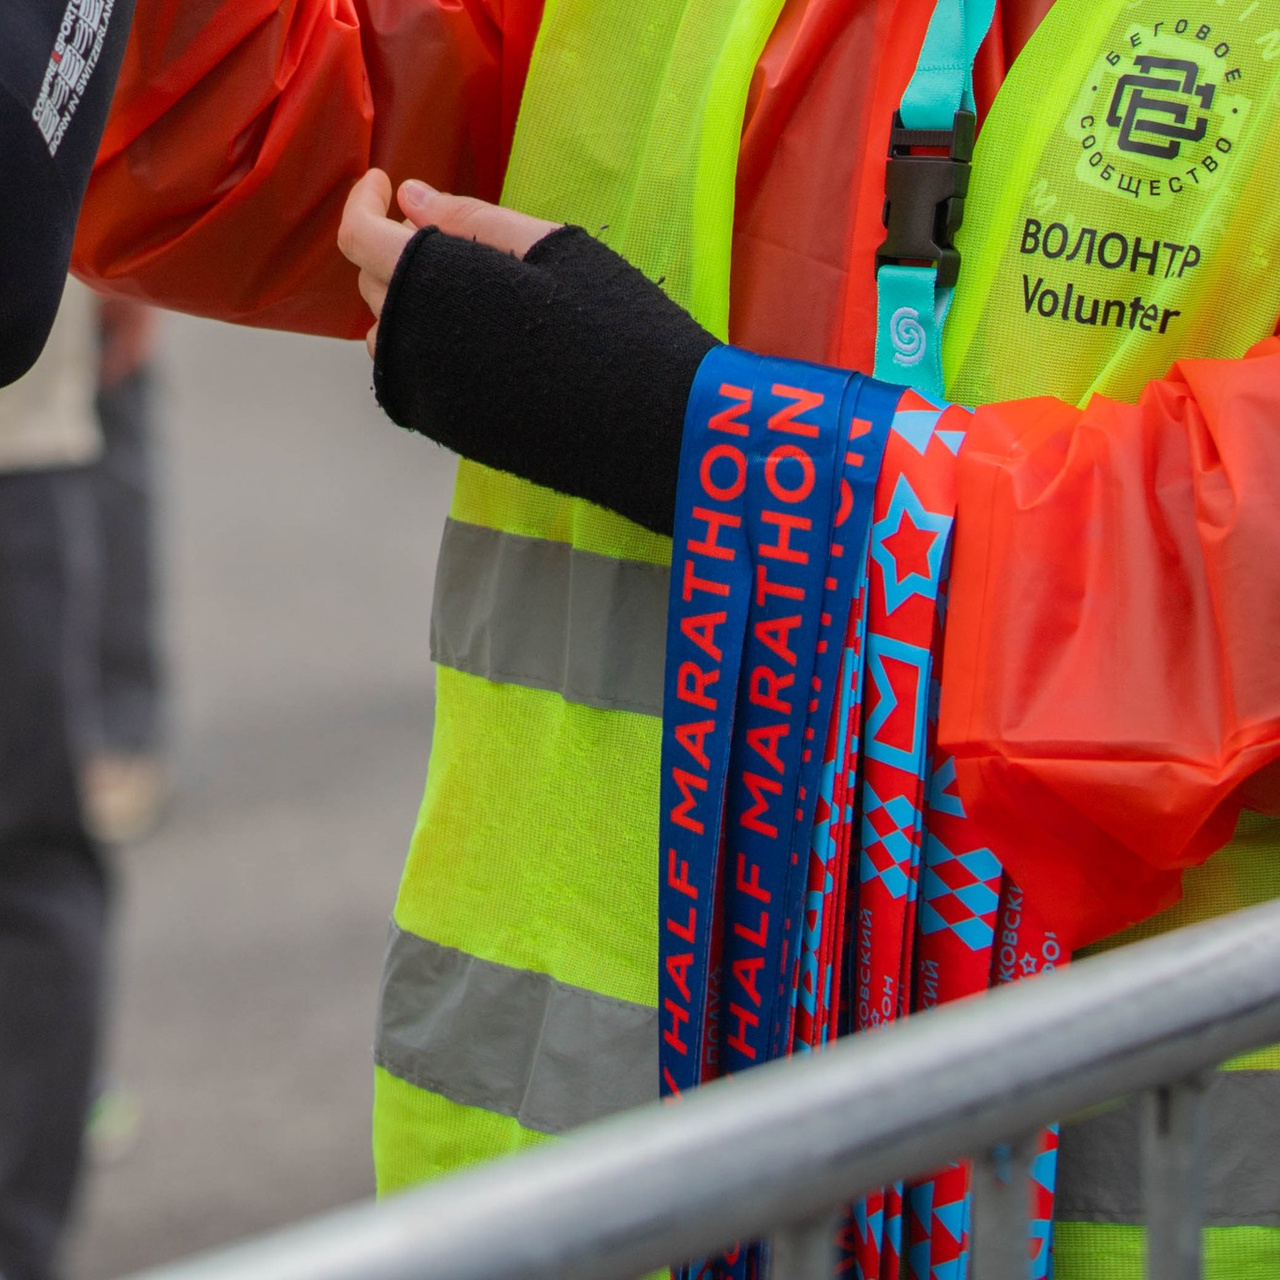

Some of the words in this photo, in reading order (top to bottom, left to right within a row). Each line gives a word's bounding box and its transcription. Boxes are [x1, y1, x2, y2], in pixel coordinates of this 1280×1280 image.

[48, 114, 72, 159] BORN
[67, 93, 81, 115] IN
[1080, 114, 1233, 198] СООБЩЕСТВО
[1105, 18, 1242, 84] БЕГОВОЕ
[671, 383, 754, 834] MARATHON
[740, 382, 824, 839] MARATHON
[663, 847, 700, 1060] HALF
[727, 850, 772, 1062] HALF
